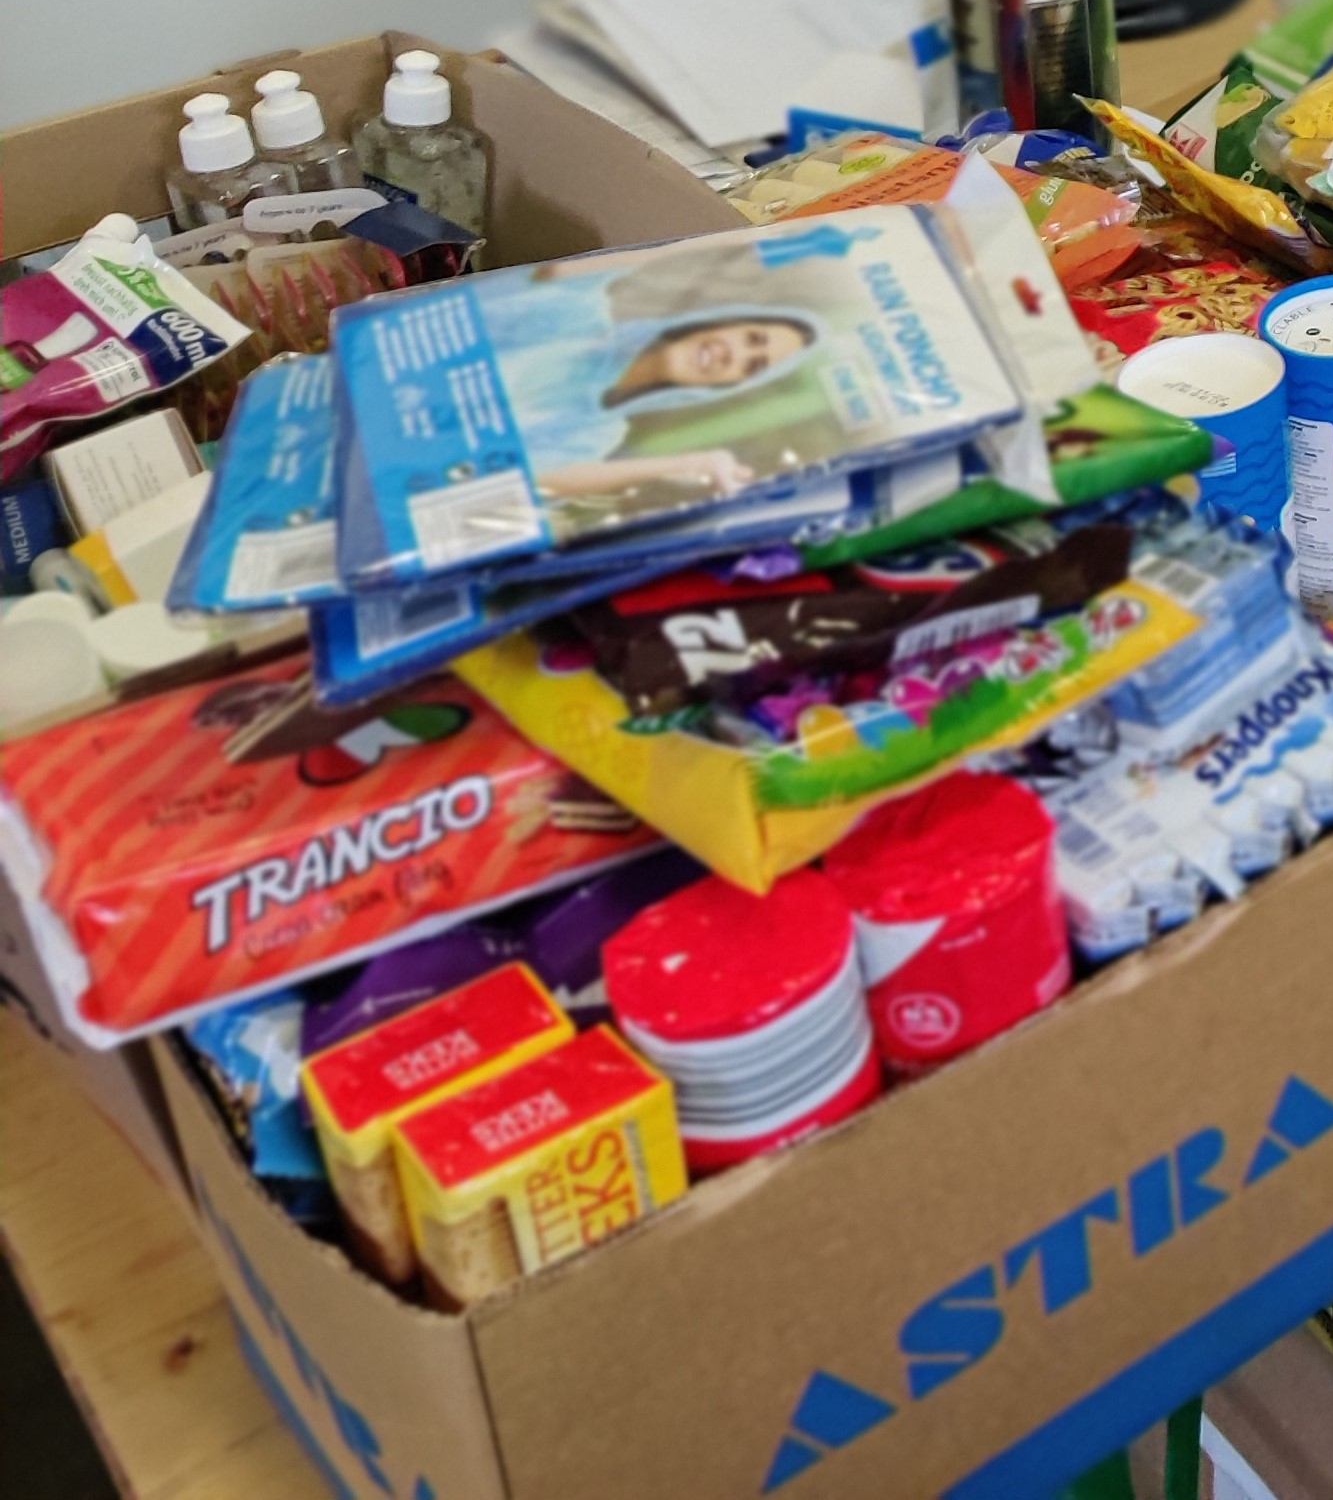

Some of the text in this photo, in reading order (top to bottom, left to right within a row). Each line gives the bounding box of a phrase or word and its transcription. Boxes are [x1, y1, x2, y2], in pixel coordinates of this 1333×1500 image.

[160, 311, 206, 341] 600
[192, 774, 495, 955] TRANCIO
[526, 1156, 582, 1262] TTER
[565, 1129, 638, 1248] EKS
